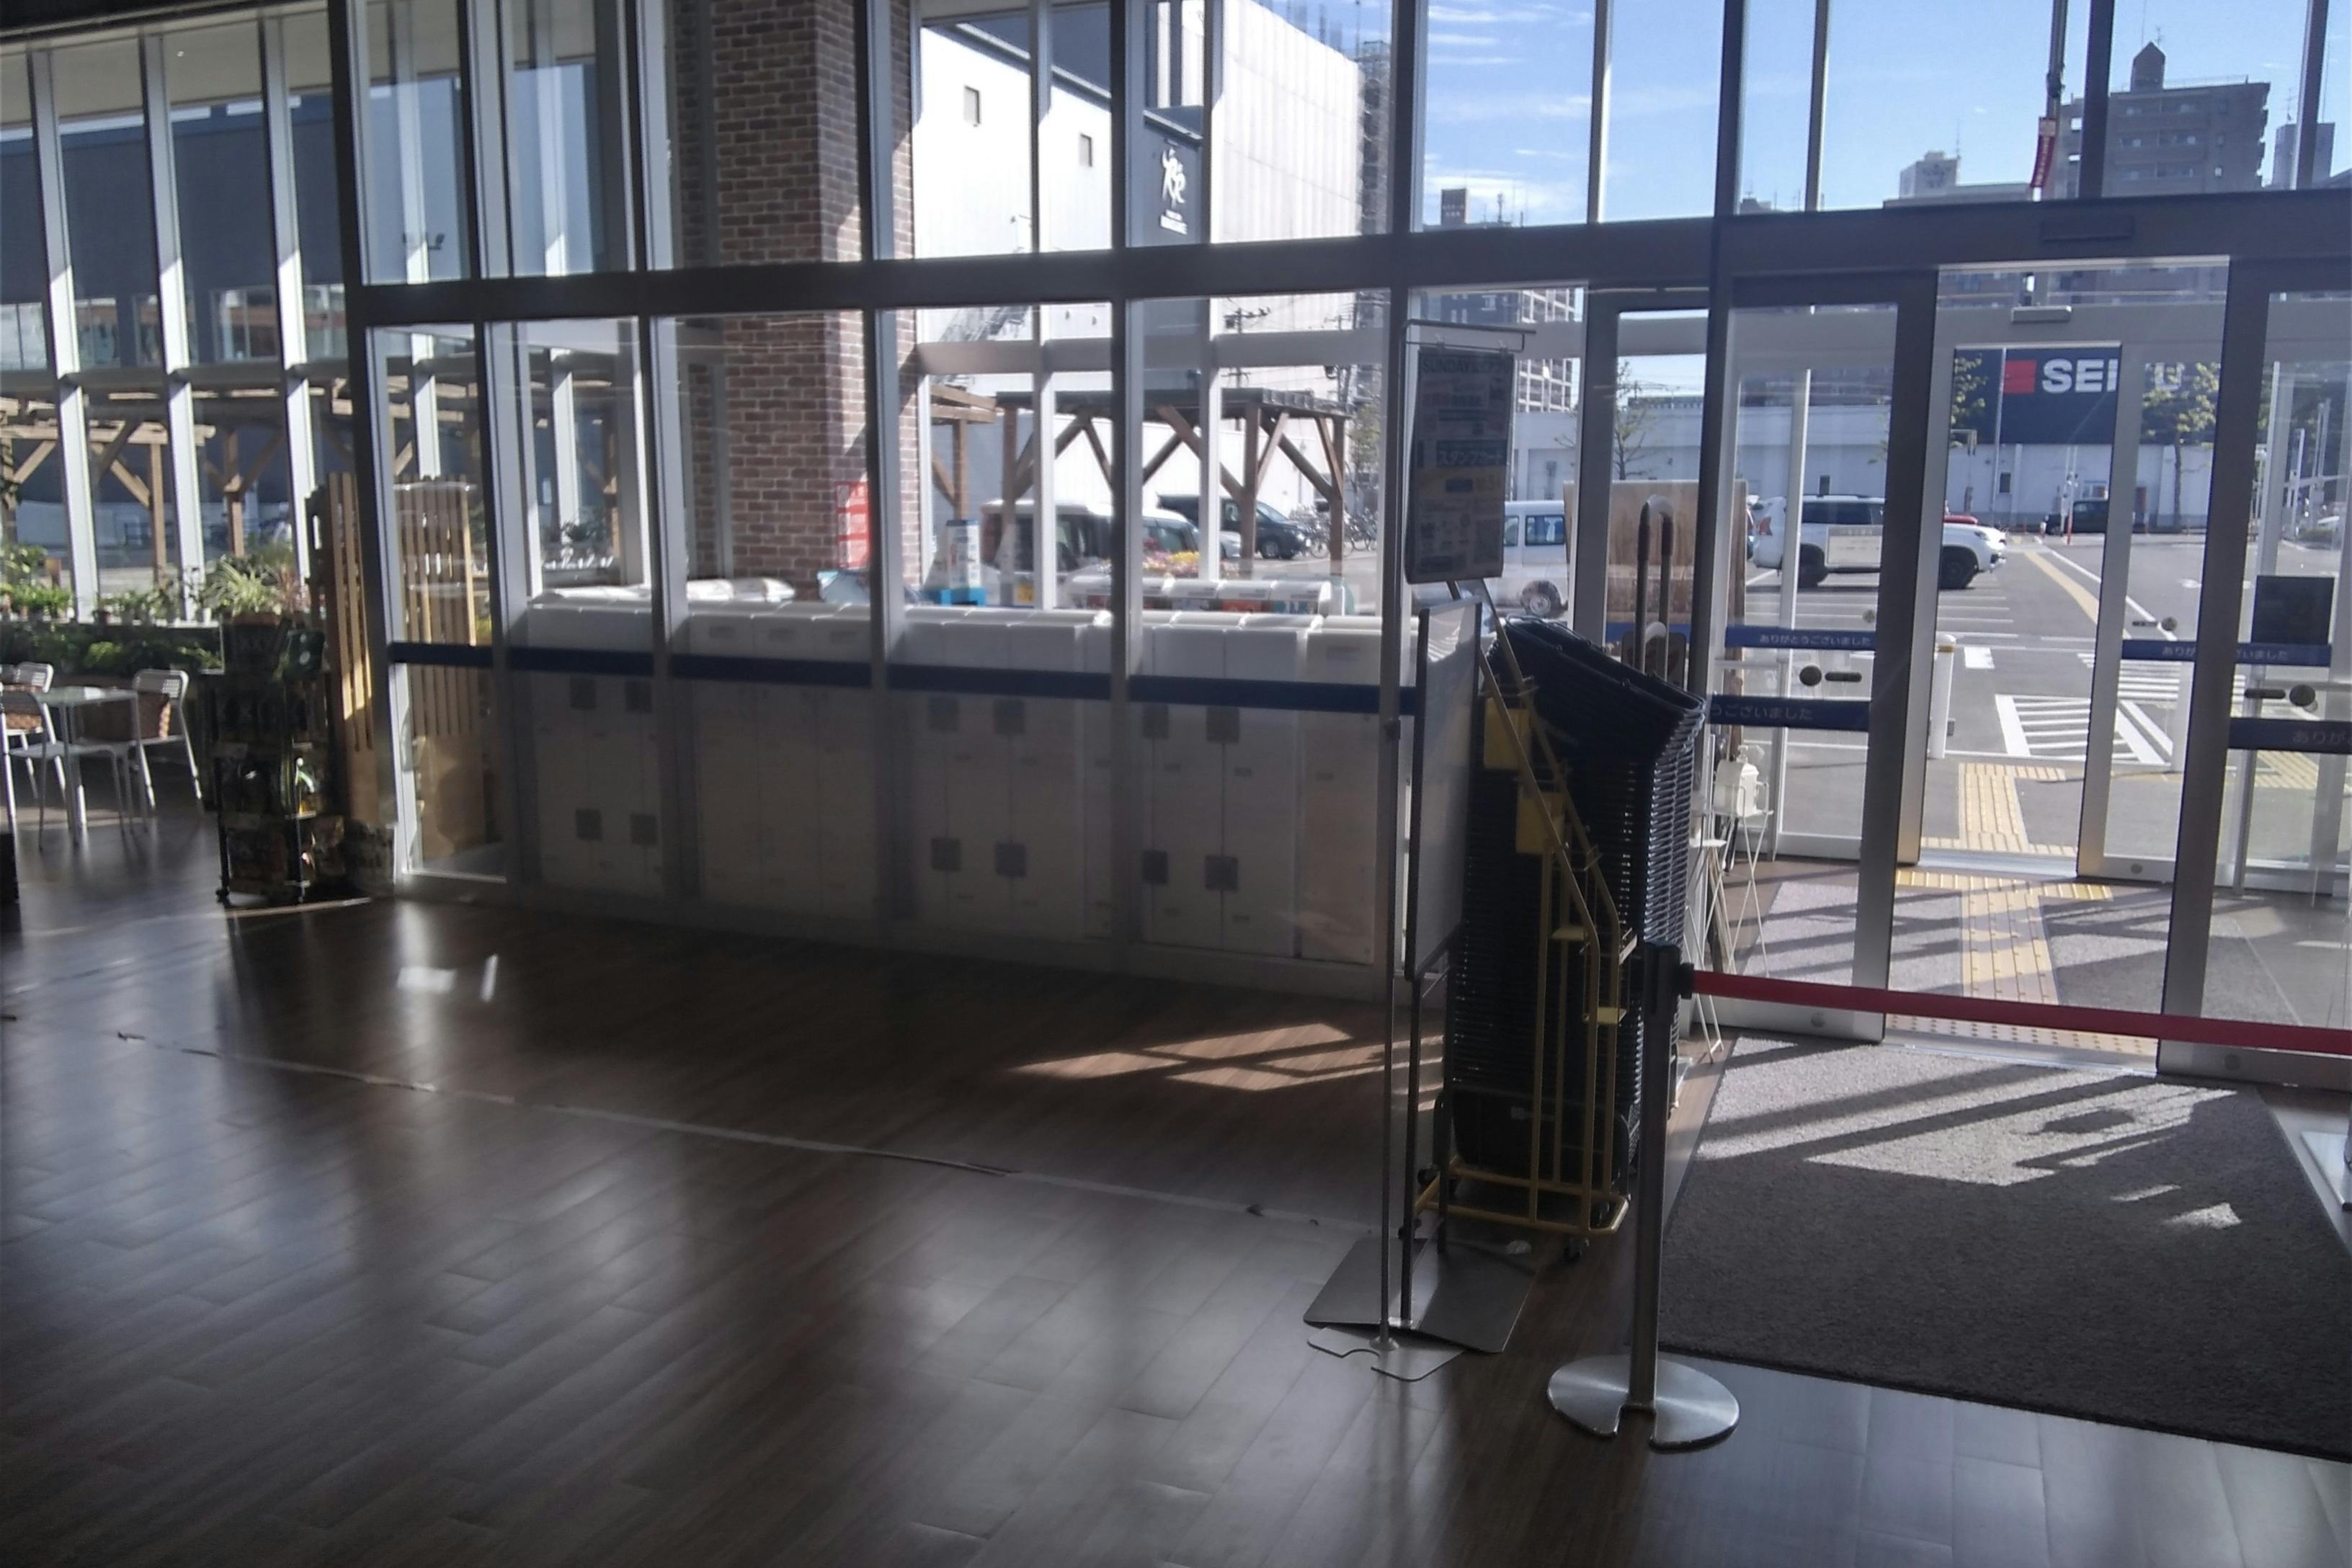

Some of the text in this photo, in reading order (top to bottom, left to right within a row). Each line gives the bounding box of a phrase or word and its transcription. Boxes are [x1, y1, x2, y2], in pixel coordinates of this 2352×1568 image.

[1759, 633, 1872, 647] ありがとうございました
[2289, 728, 2352, 744] ありが
